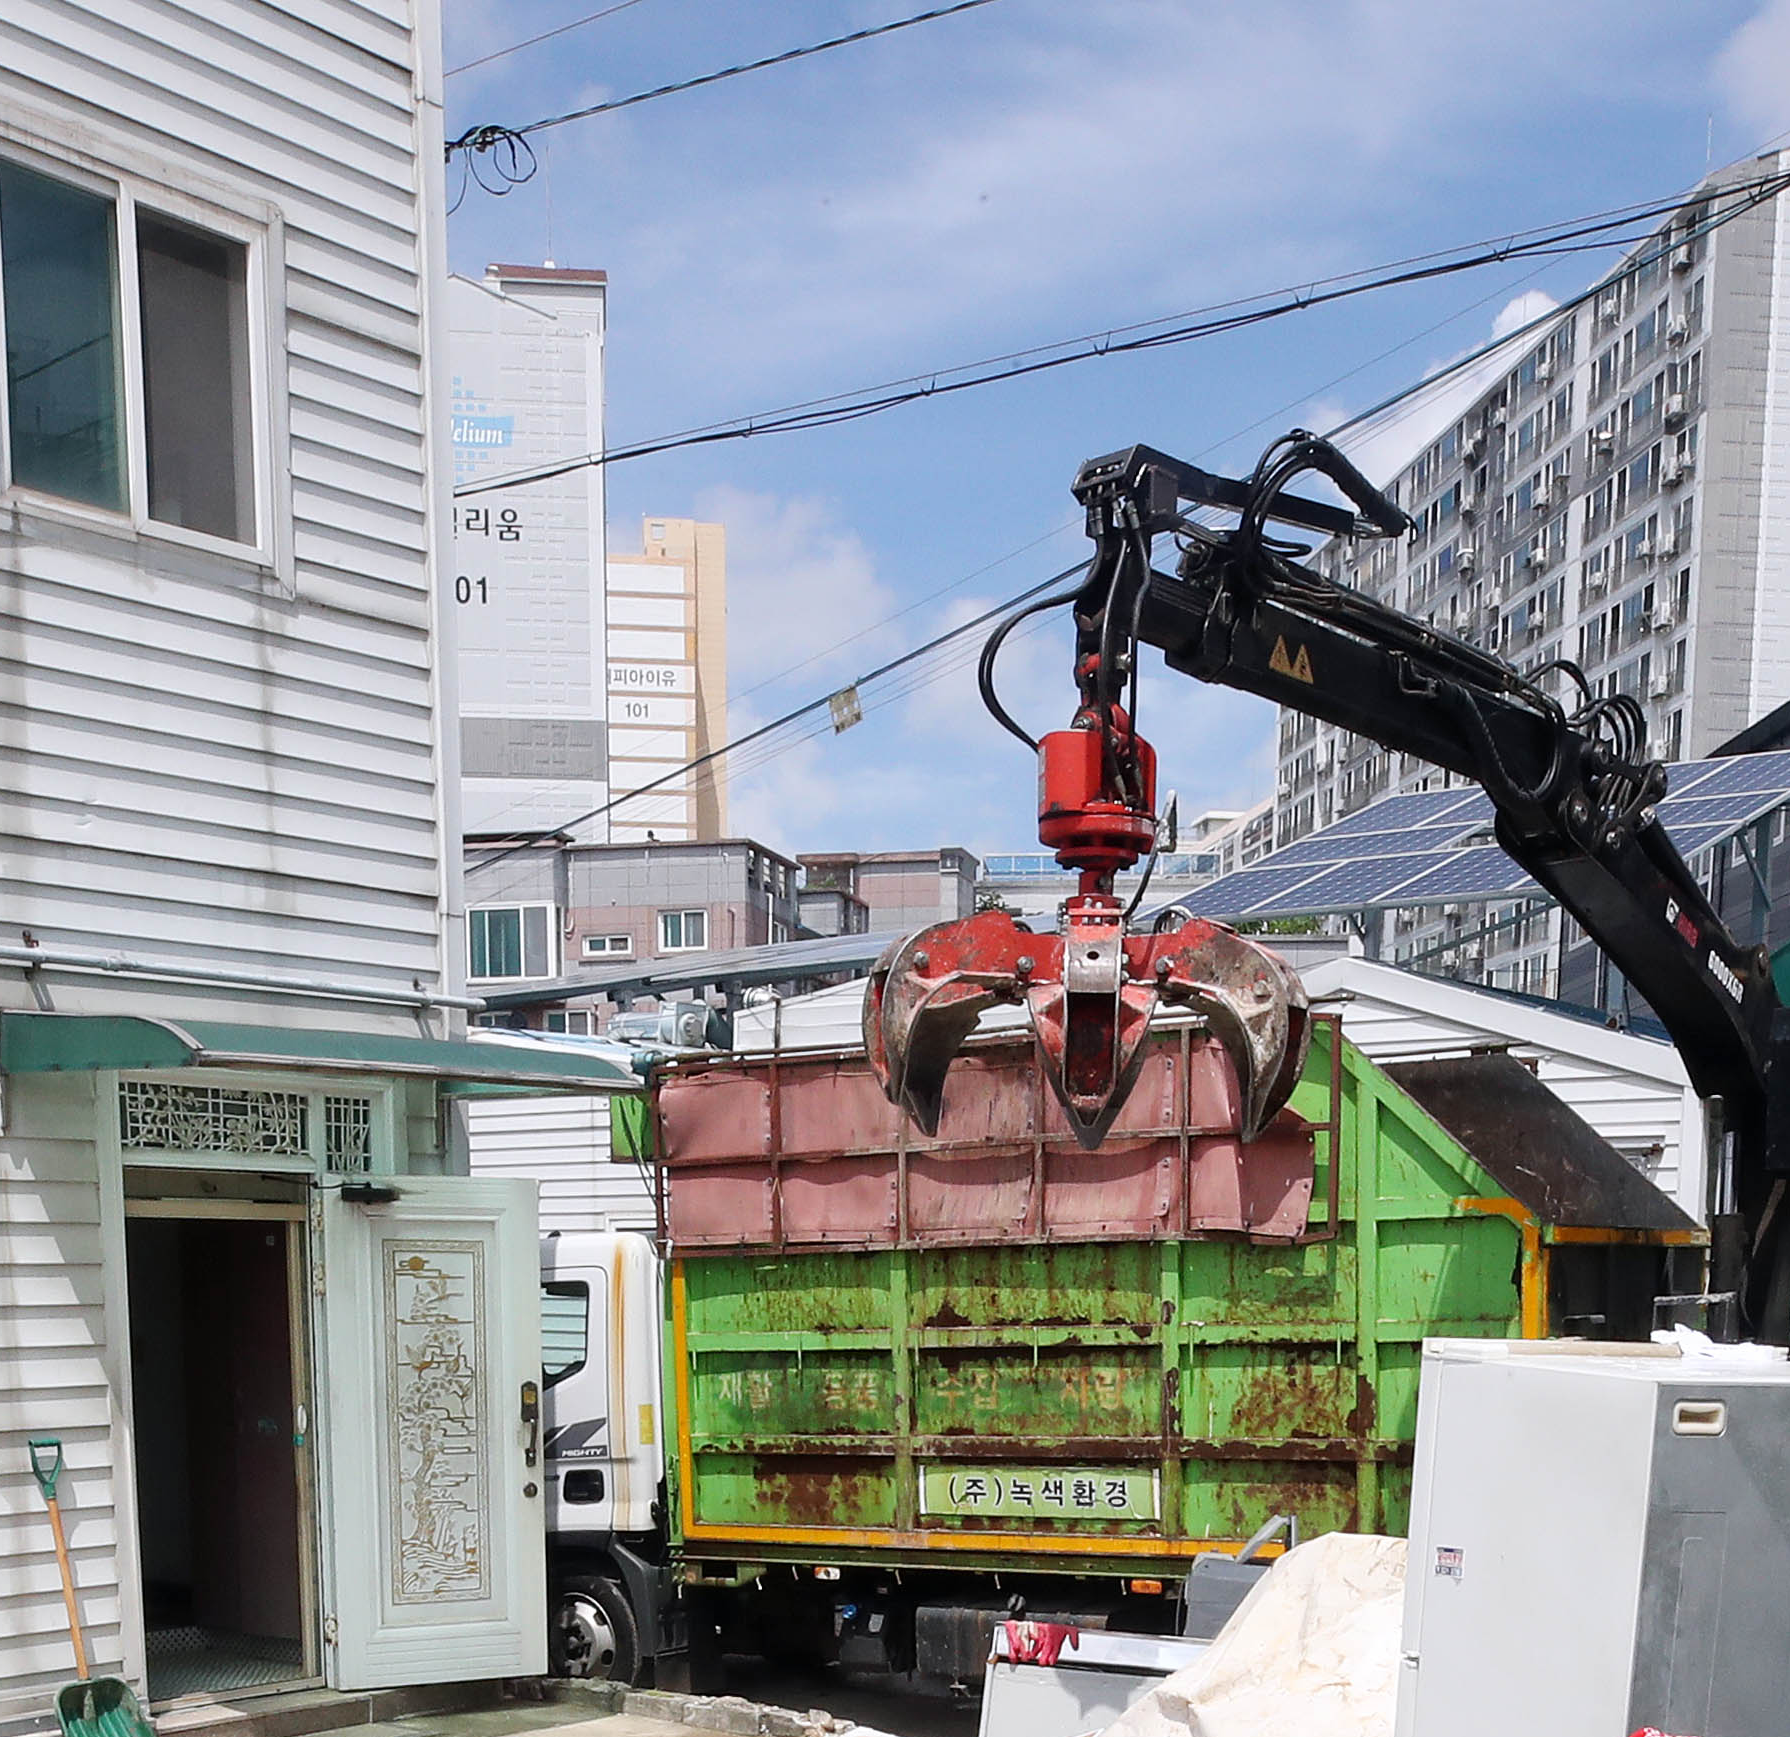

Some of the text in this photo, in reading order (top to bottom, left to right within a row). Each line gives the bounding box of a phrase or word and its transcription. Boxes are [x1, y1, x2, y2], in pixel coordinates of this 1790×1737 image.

[453, 506, 523, 542] 리움
[608, 668, 677, 687] 피아이유
[626, 703, 649, 718] 101
[561, 1447, 604, 1458] MIGHTY
[949, 1475, 1128, 1508] (주)녹색환경
